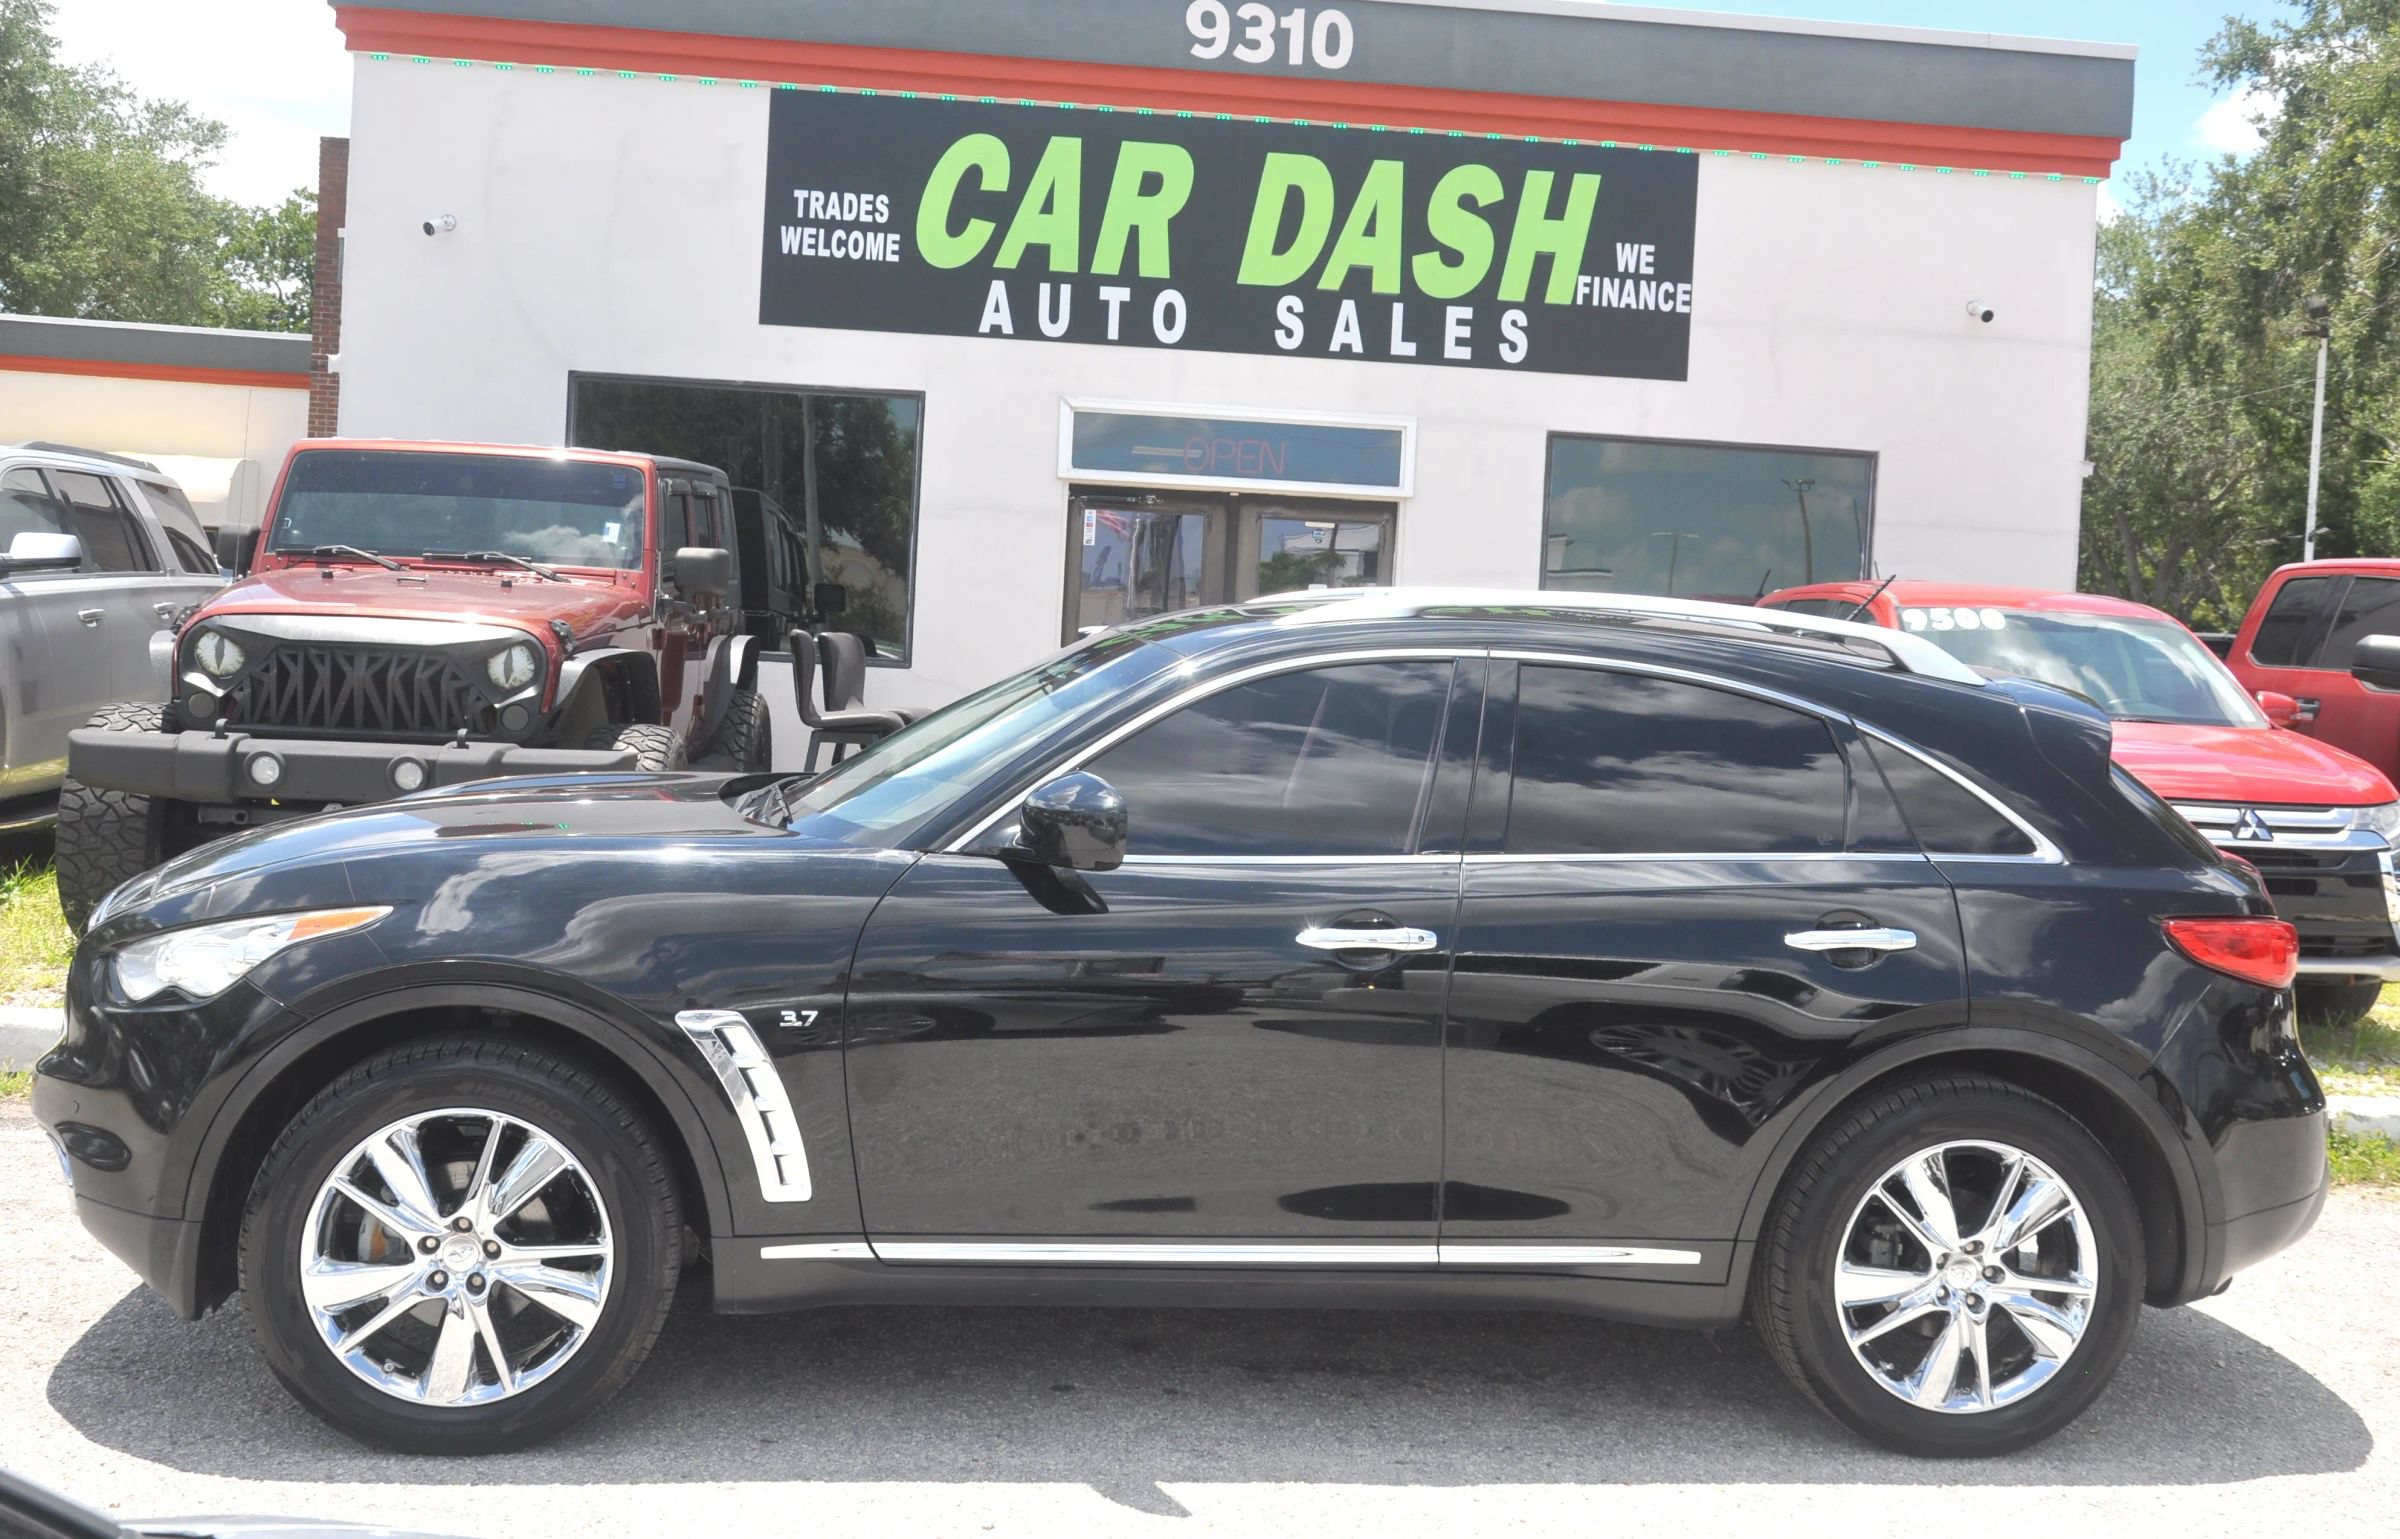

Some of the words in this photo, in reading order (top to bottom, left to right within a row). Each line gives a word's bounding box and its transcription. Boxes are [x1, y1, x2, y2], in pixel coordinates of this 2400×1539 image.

[1186, 0, 1354, 70] 9310
[793, 189, 890, 224] TRADES
[916, 133, 1195, 279] CAR
[1236, 152, 1602, 305] DASH
[780, 225, 900, 263] WELCOME
[1616, 242, 1655, 275] WE
[1576, 275, 1692, 314] FINANCE
[978, 279, 1187, 344] AUTO
[1274, 295, 1529, 364] SALES
[1182, 437, 1289, 475] OPEN
[1902, 607, 2006, 632] 9500
